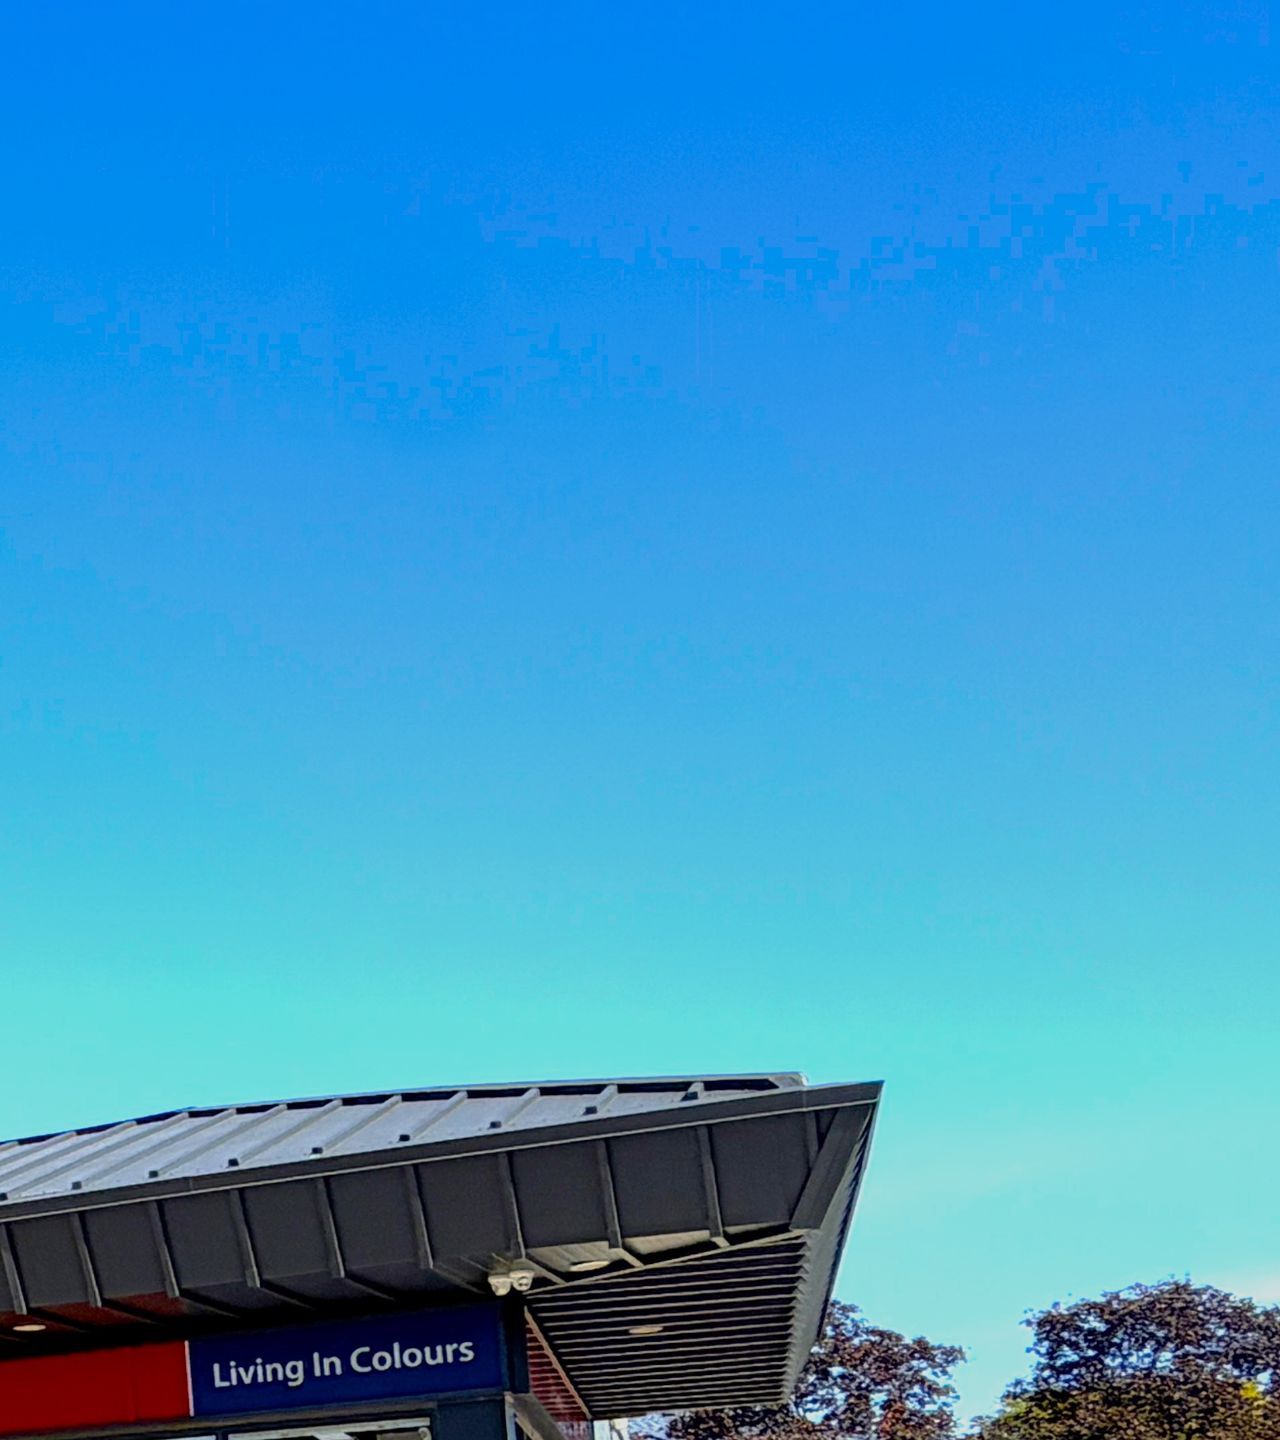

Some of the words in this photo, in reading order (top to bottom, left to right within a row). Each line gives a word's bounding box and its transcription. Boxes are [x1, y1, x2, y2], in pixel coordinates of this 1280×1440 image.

[213, 1357, 305, 1387] Living
[313, 1352, 342, 1377] In
[350, 1341, 475, 1373] Colours
